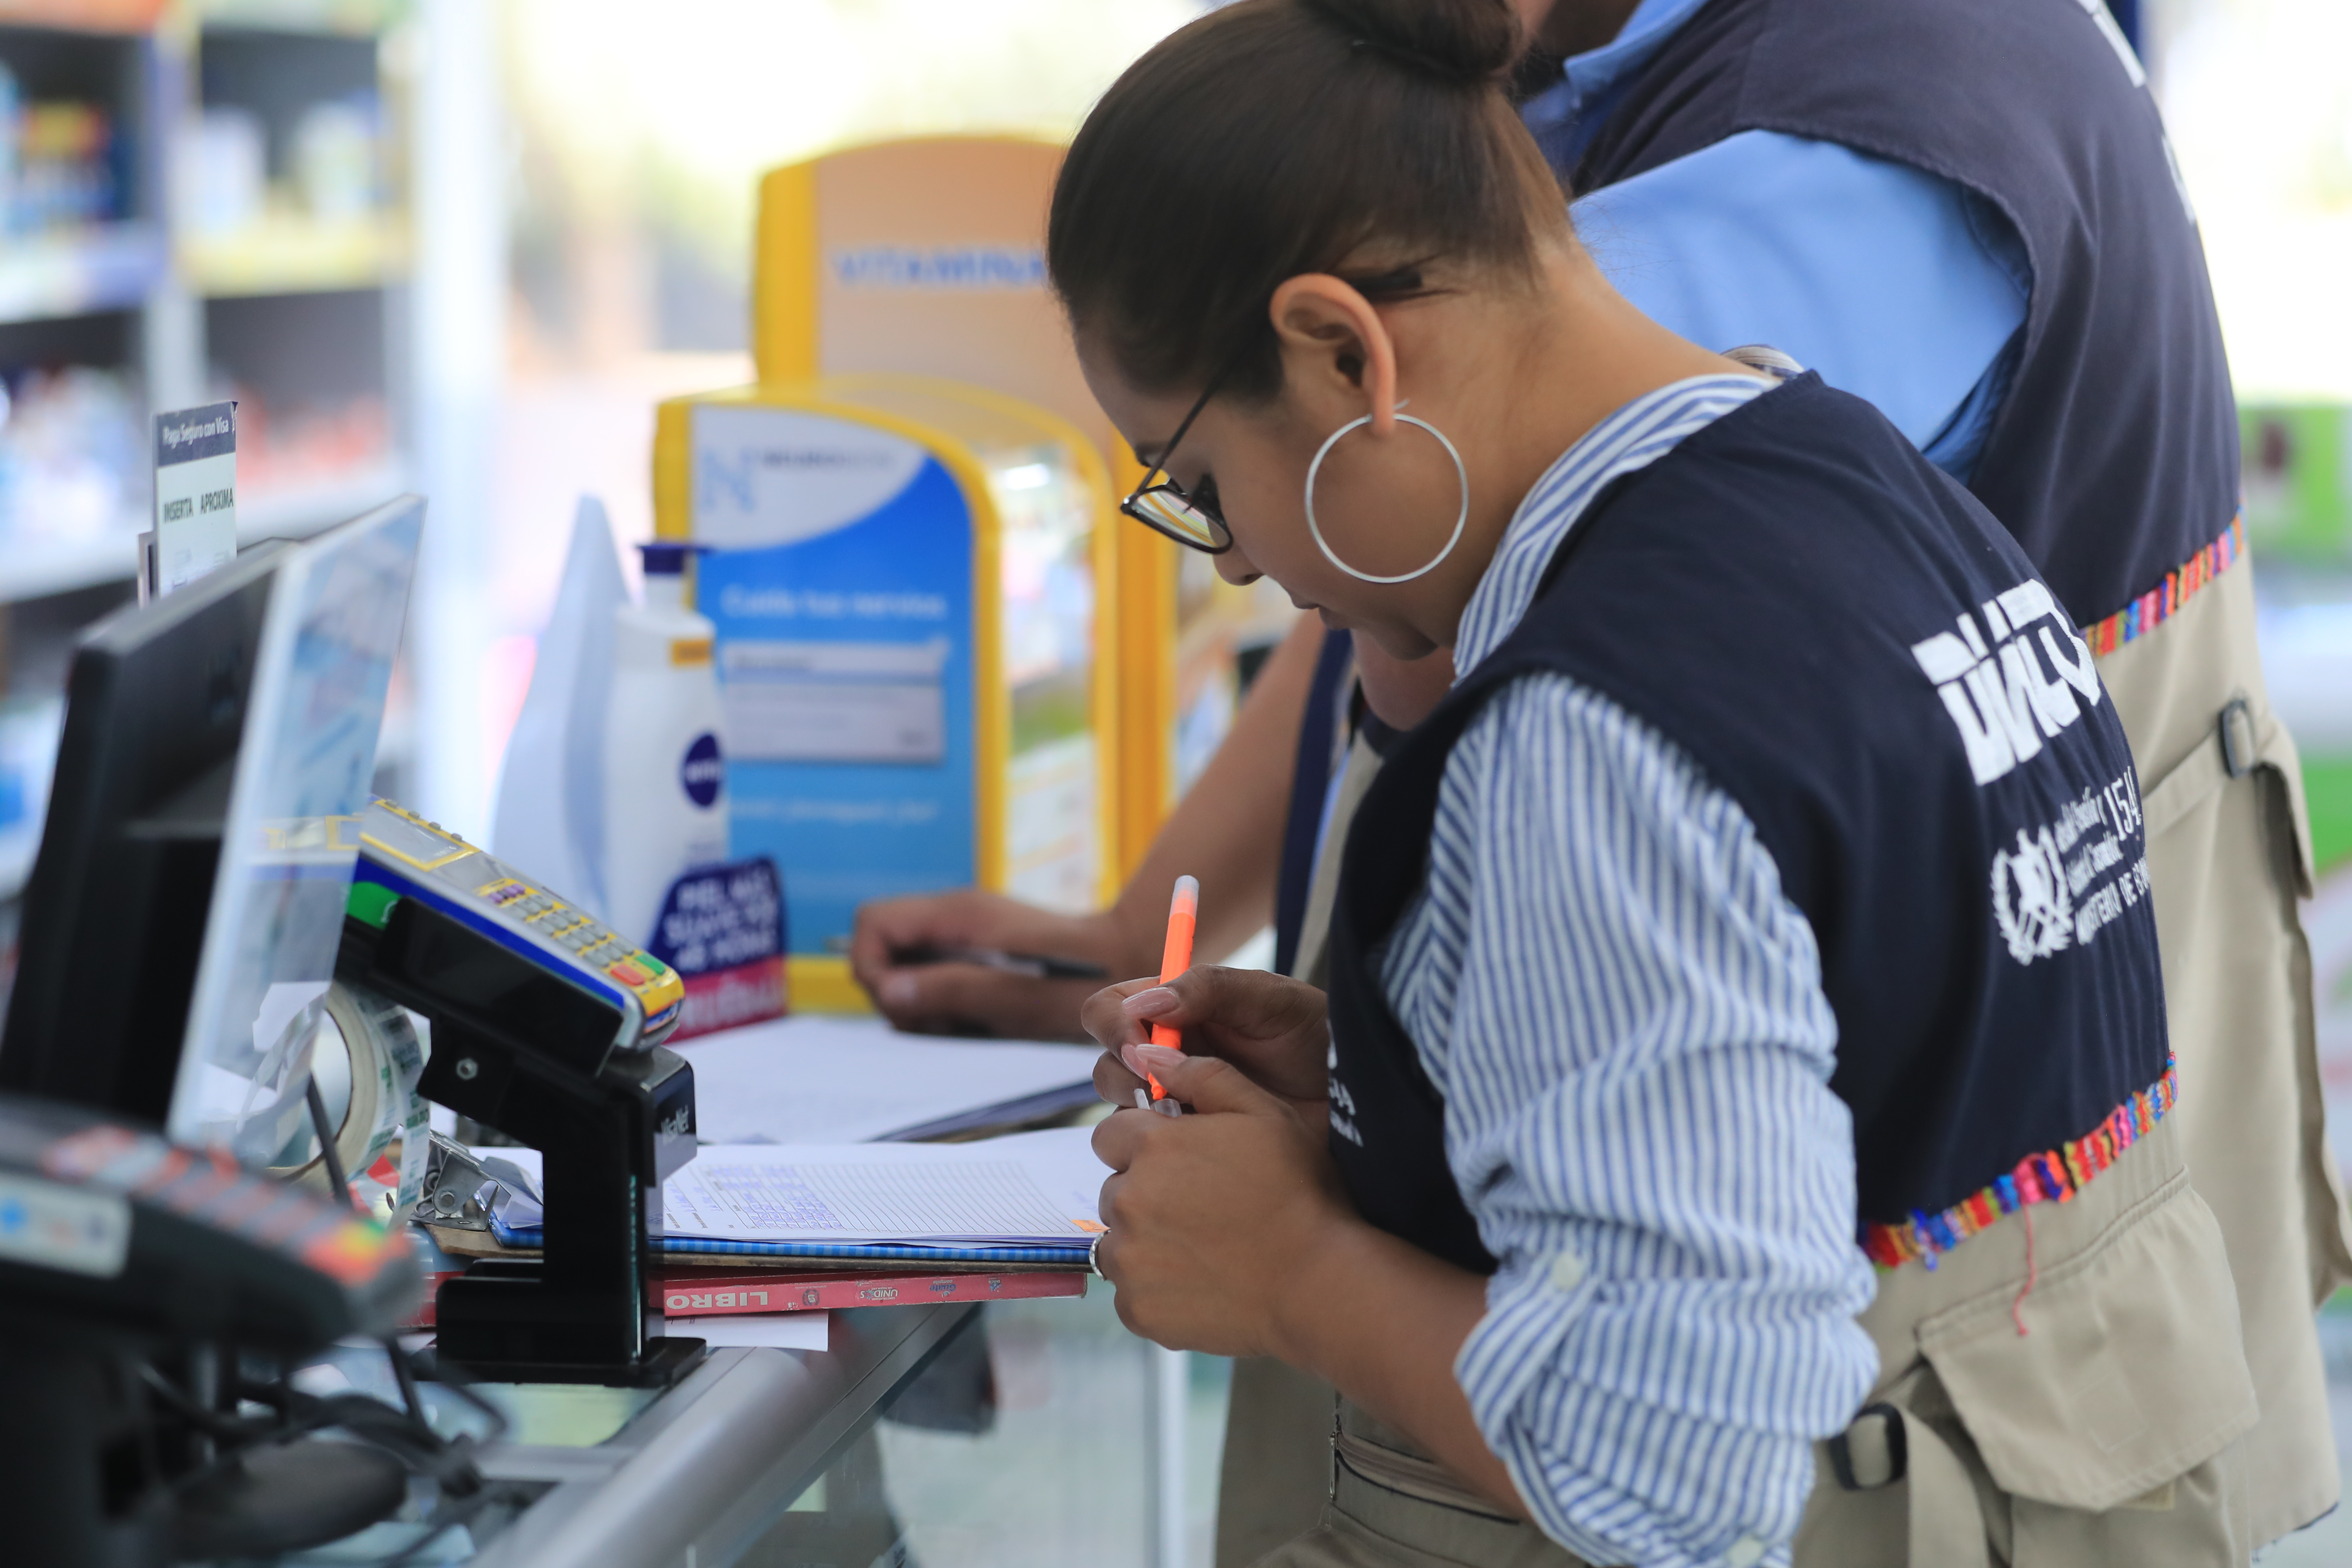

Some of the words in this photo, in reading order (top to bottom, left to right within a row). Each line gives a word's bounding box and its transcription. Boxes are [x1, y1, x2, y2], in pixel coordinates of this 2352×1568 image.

[181, 422, 204, 446] Seguro
[204, 422, 215, 438] con
[215, 416, 229, 435] Visa
[164, 497, 193, 524] INSERTA
[201, 487, 234, 514] APROXIMA
[2075, 882, 2123, 946] STERIO
[2118, 872, 2137, 907] DE
[666, 1291, 768, 1310] LIBRO
